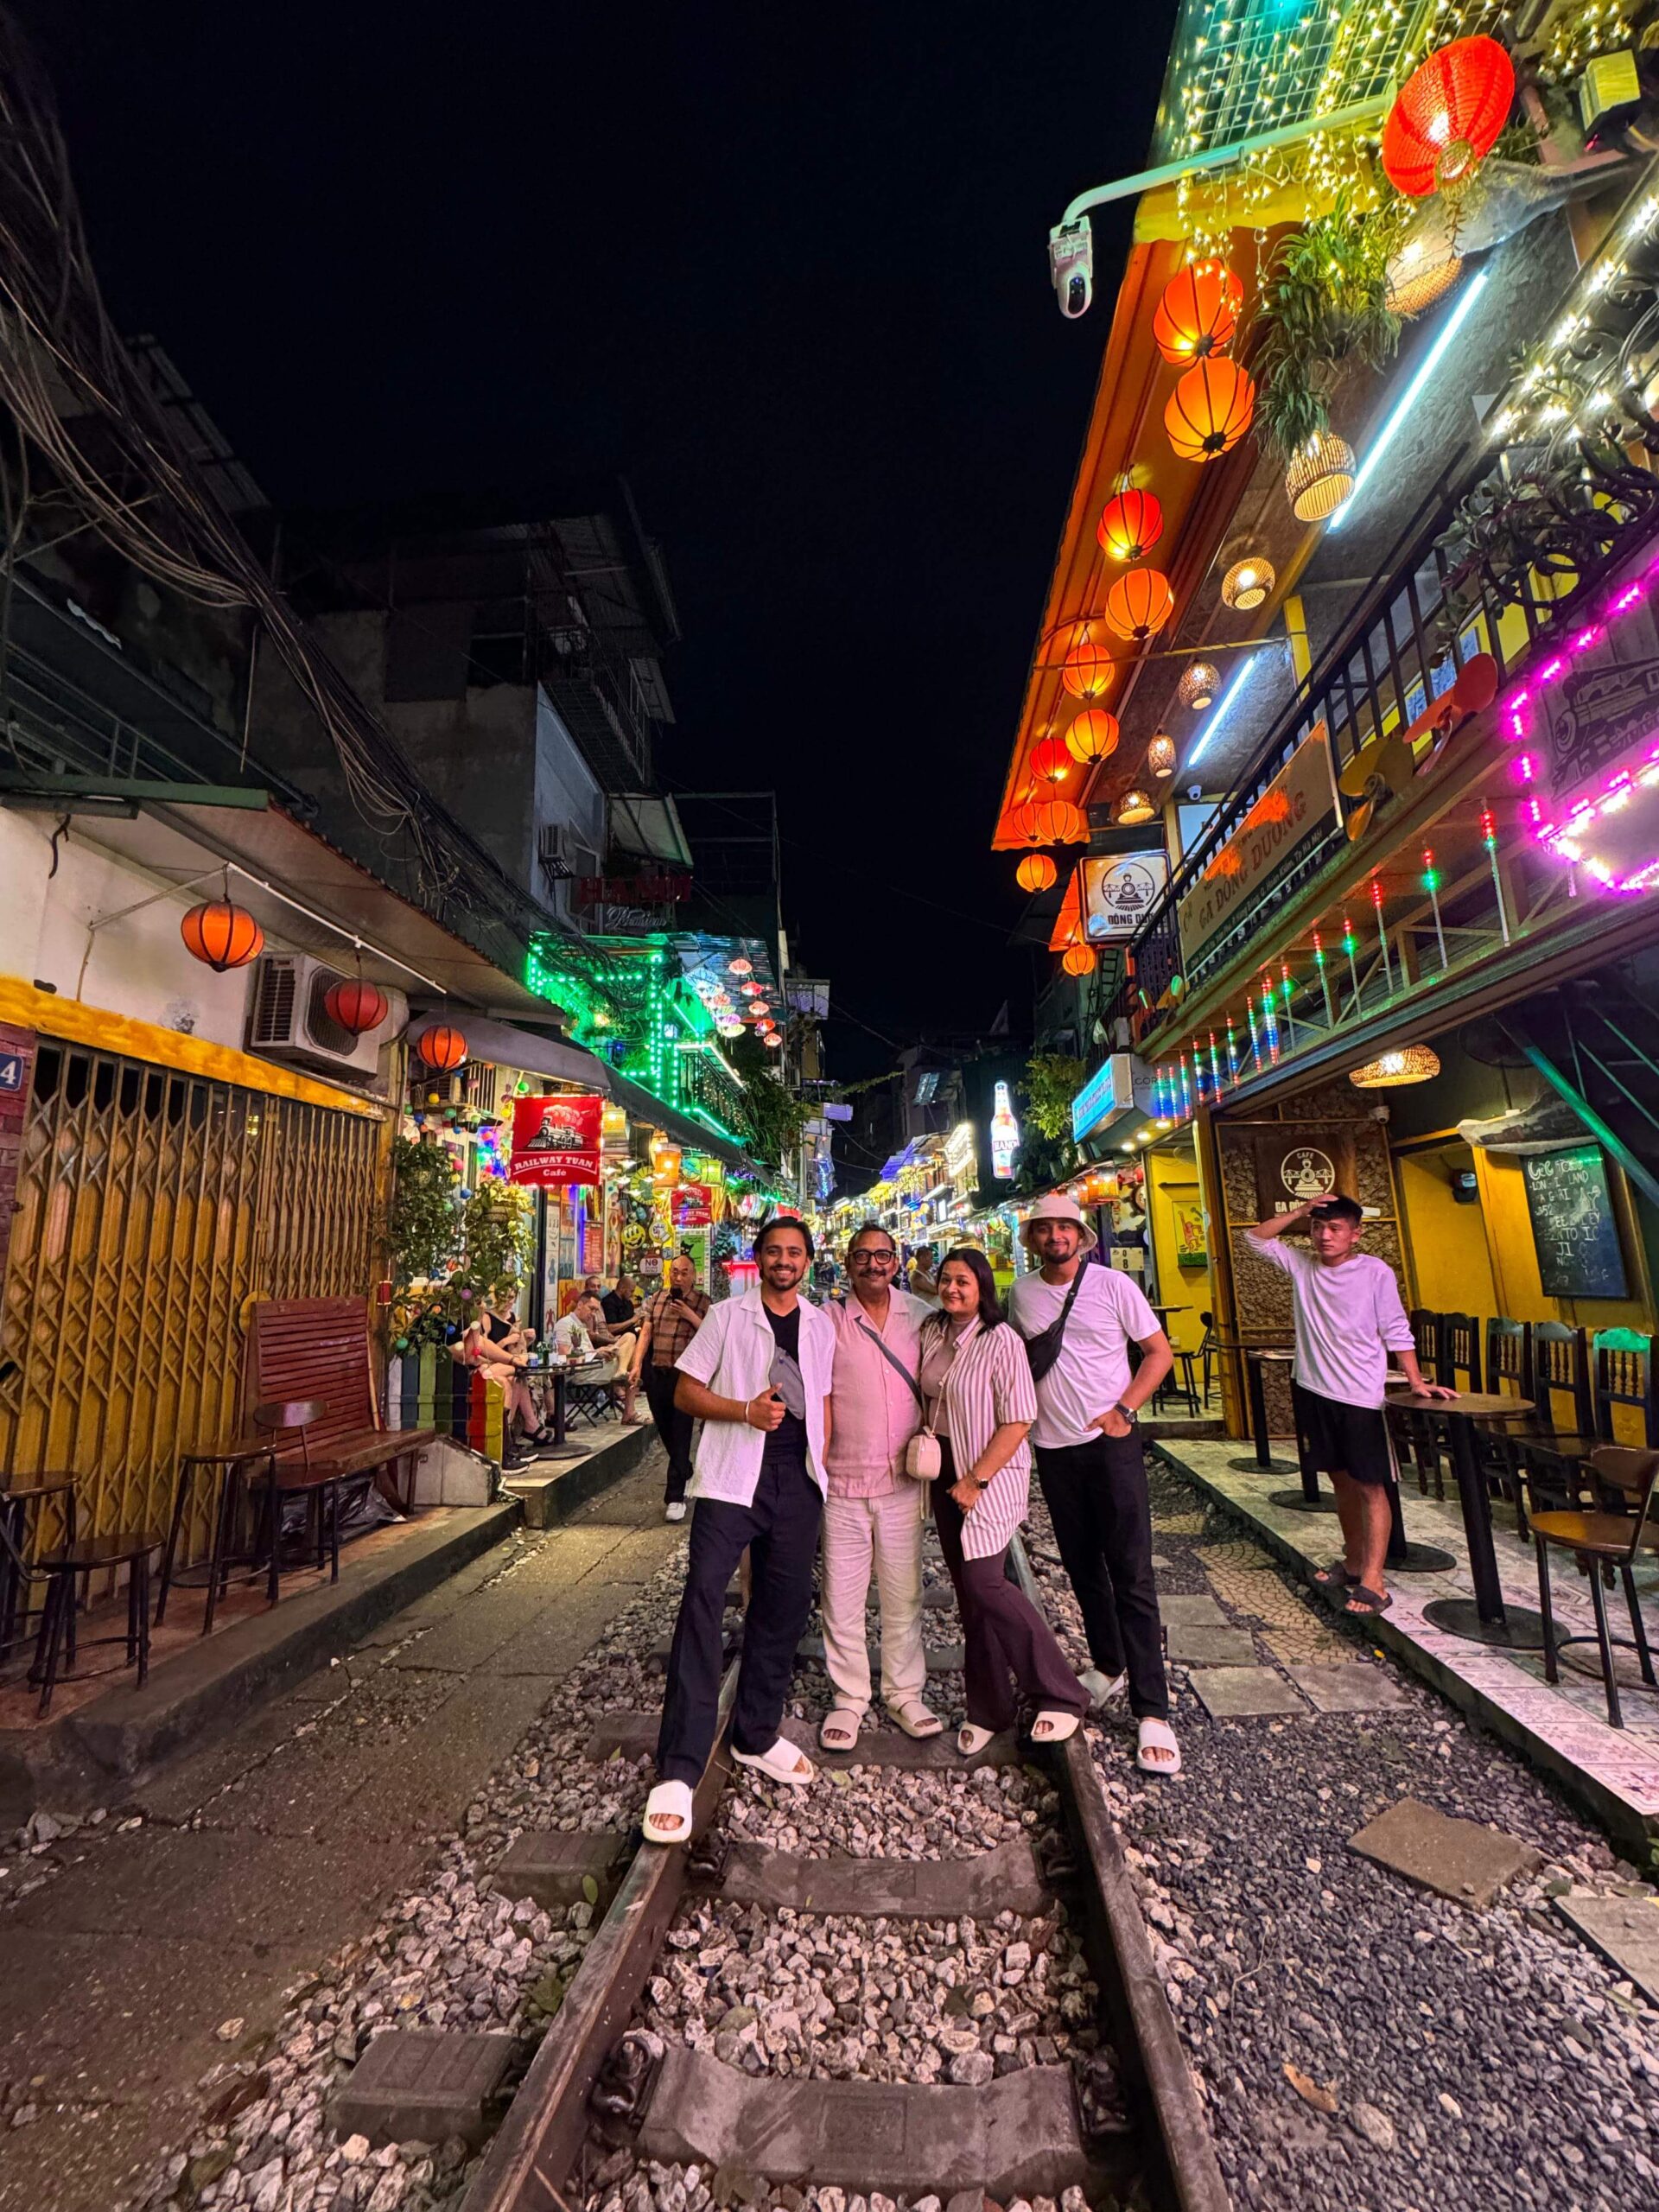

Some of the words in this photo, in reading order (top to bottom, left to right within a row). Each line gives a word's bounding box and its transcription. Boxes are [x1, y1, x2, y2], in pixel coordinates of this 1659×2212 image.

[514, 1155, 563, 1171] RAILWAY
[565, 1156, 594, 1168] TUAN
[1274, 1201, 1287, 1213] GA
